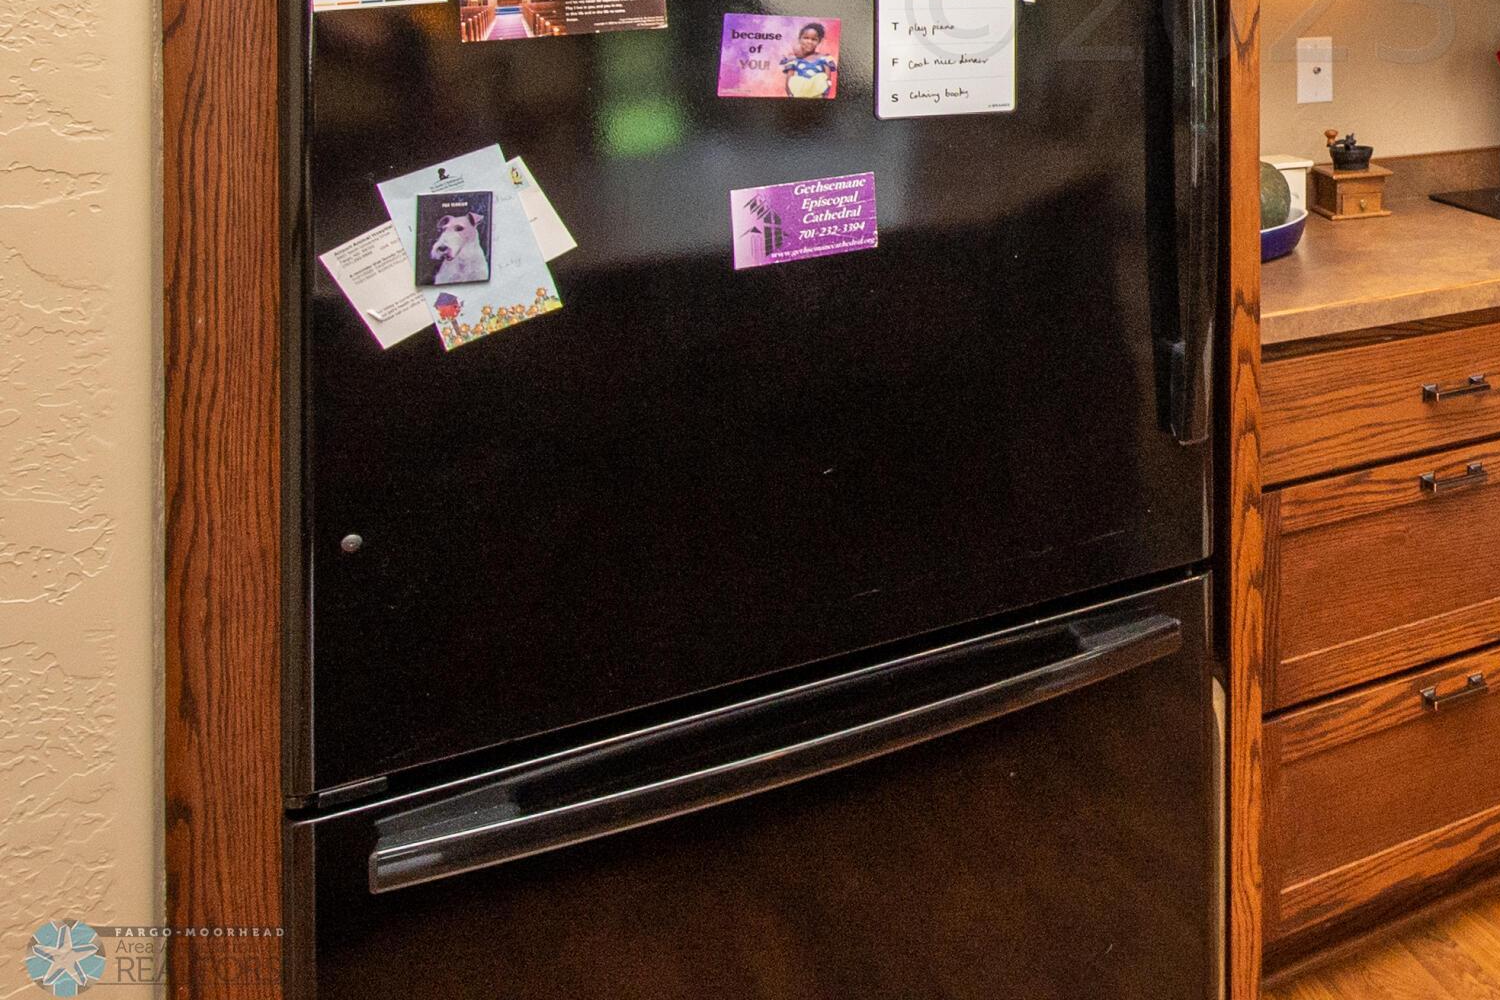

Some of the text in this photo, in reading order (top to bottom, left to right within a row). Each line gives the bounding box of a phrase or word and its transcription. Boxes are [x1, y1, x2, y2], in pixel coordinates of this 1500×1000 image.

[891, 22, 899, 31] T
[908, 21, 955, 36] play piano
[731, 29, 783, 41] because
[748, 44, 763, 54] of
[739, 59, 771, 70] YOU!
[891, 58, 899, 67] F
[891, 93, 899, 102] S
[793, 178, 867, 196] Gethsemane
[801, 191, 859, 212] Episcopal
[802, 205, 862, 225] Cathedral
